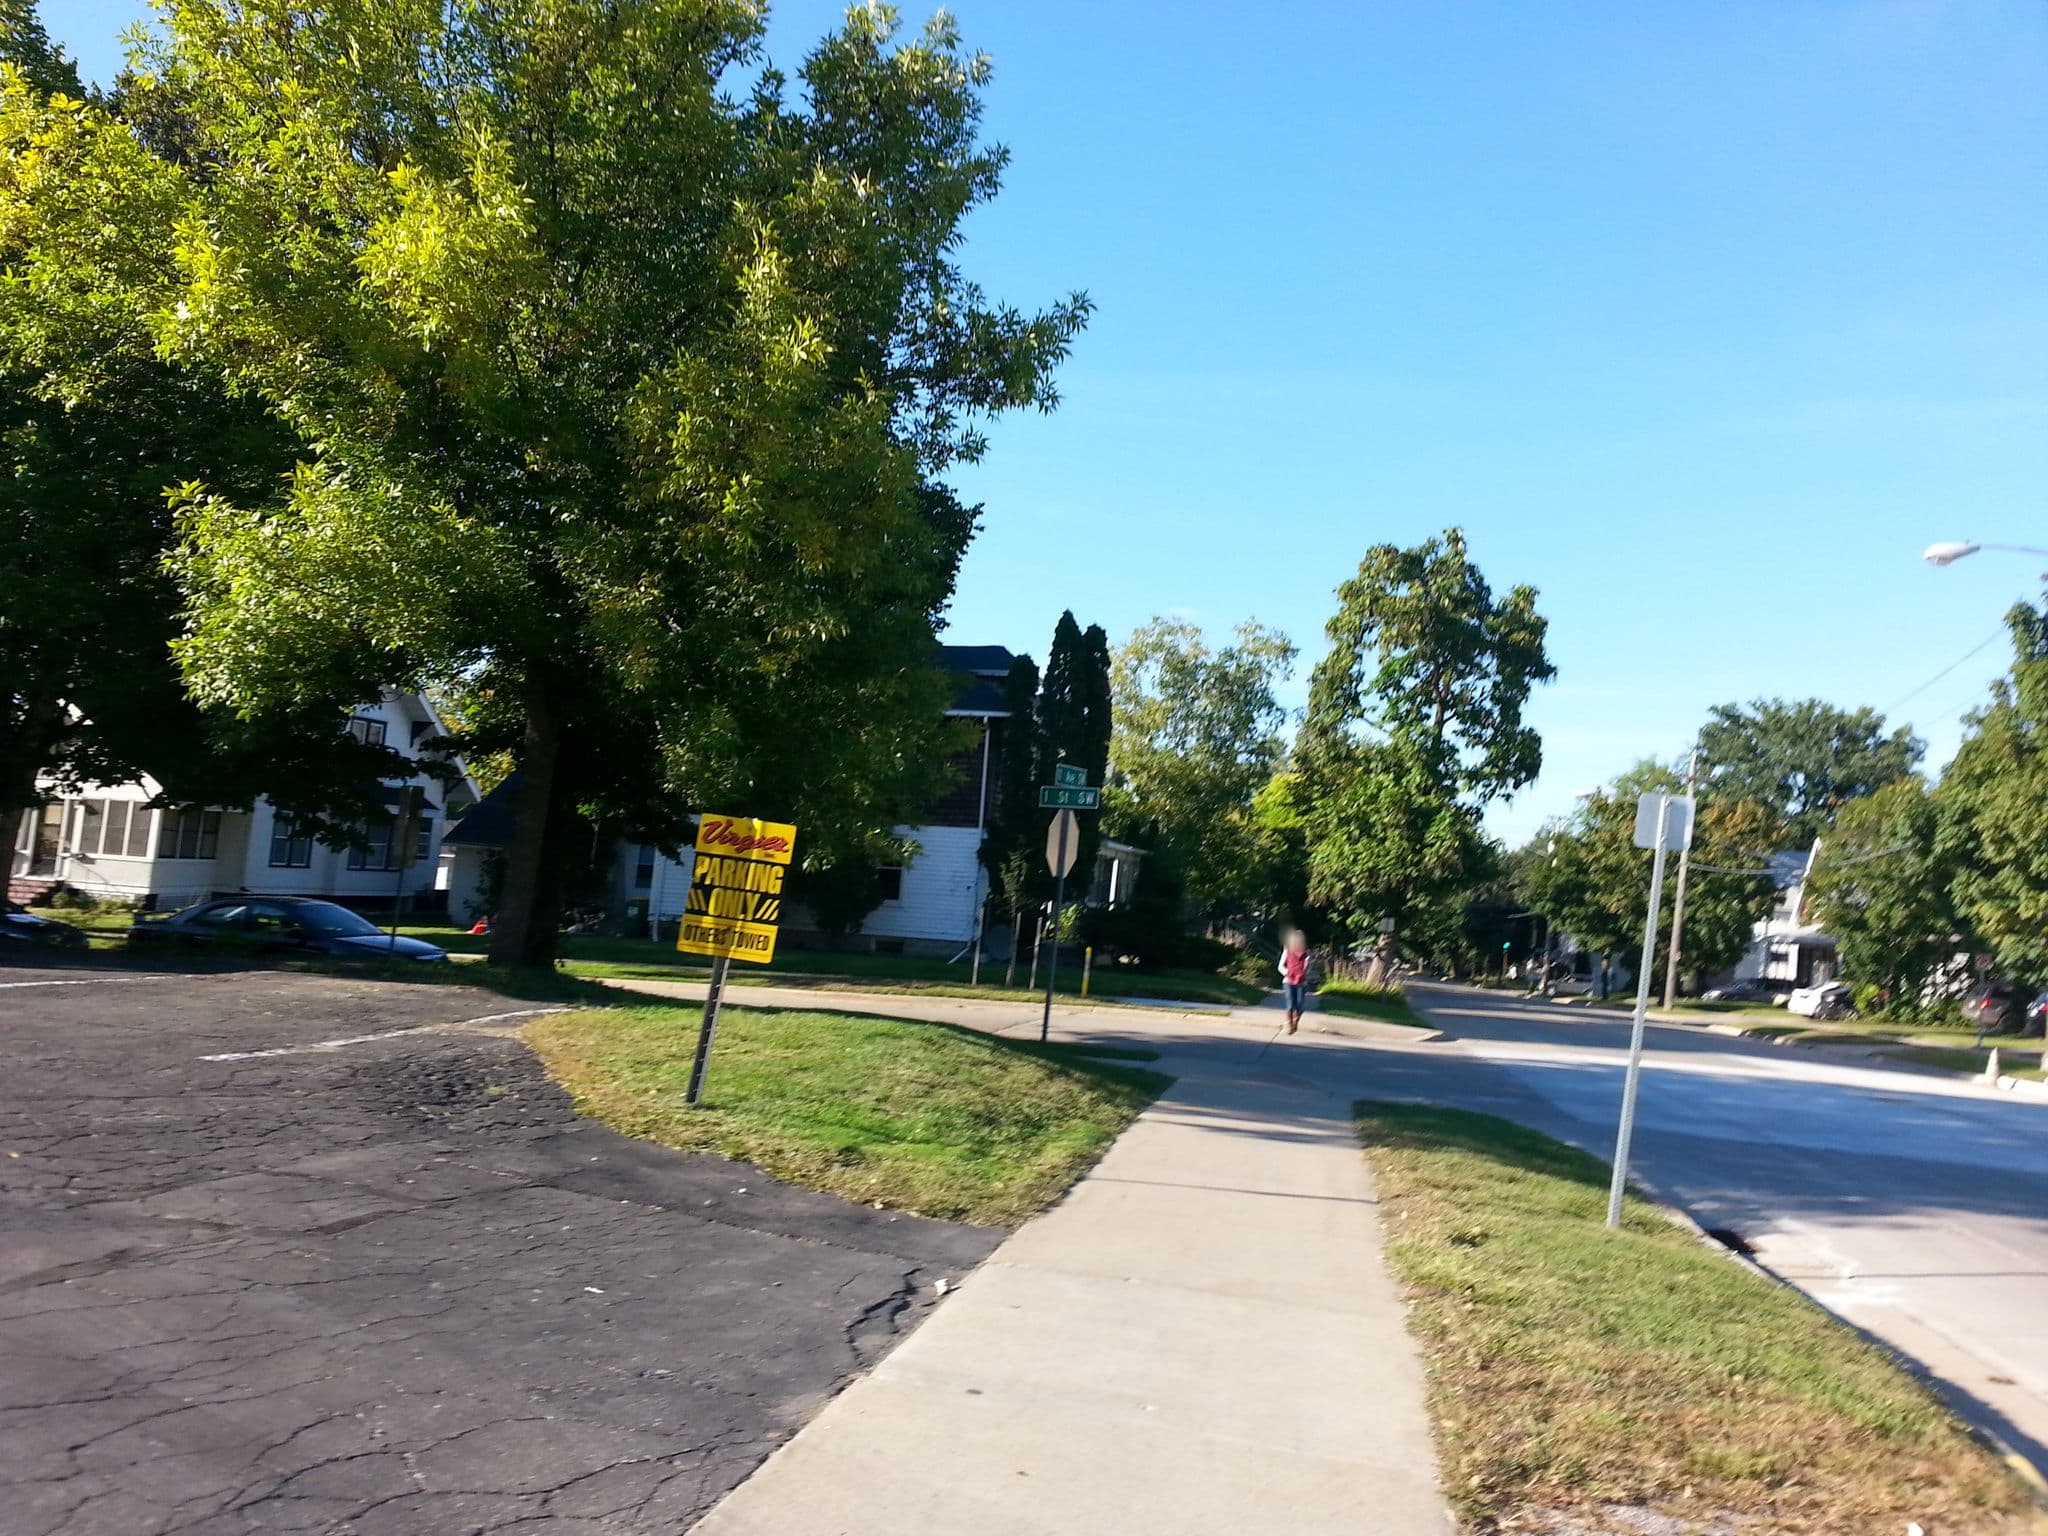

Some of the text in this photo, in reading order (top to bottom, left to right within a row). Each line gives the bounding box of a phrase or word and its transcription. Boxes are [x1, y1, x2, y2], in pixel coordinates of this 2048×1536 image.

[1057, 790, 1070, 804] St
[1078, 790, 1096, 805] SW
[693, 855, 785, 895] PARKING
[707, 887, 761, 921] ONLY
[684, 923, 770, 951] OTHERS TOWED
